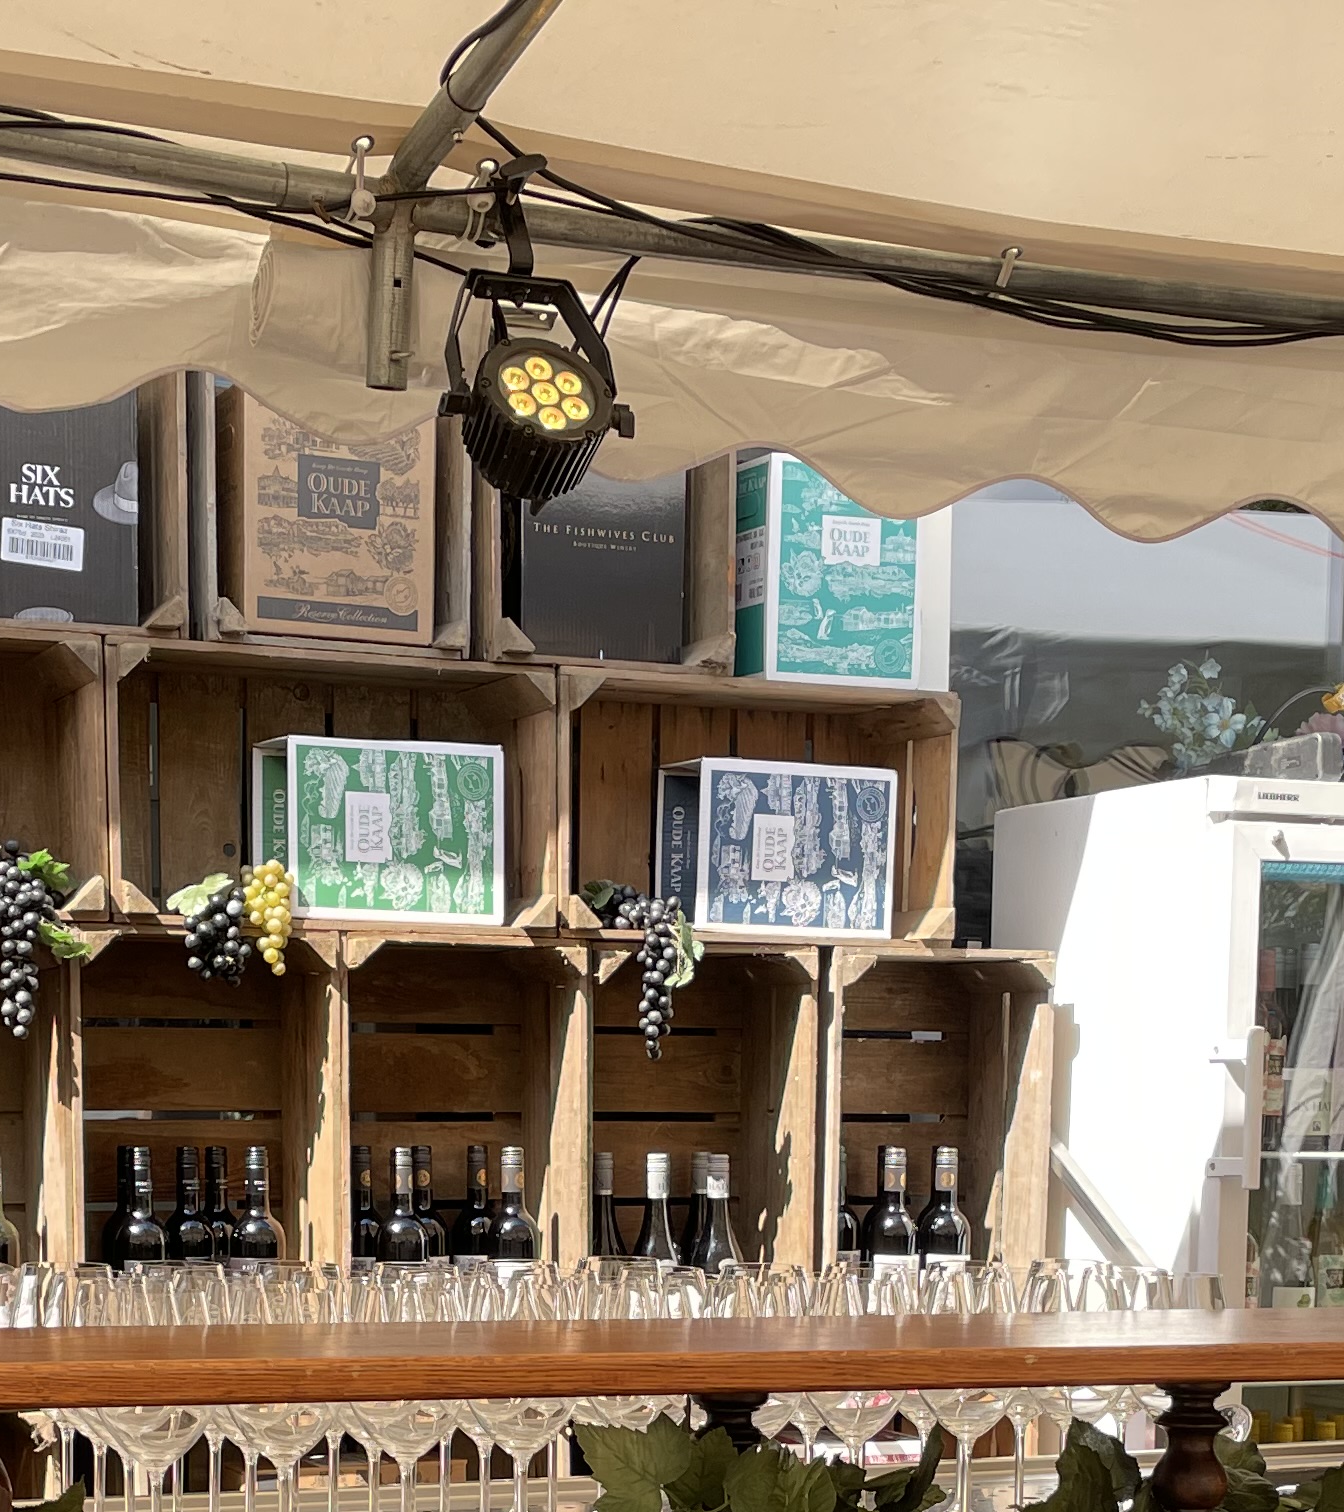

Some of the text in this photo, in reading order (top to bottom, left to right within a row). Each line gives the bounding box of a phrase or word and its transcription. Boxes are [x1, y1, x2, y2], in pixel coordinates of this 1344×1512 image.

[21, 463, 61, 486] SIX
[307, 472, 371, 498] OUDE
[9, 483, 74, 508] HATS
[311, 492, 370, 517] KAAP
[533, 521, 675, 544] THE FISHWIVES CLUB
[829, 527, 872, 544] OUDE
[831, 541, 870, 558] KAAP
[337, 606, 388, 624] Collection
[272, 788, 287, 859] OUDE KA
[357, 804, 371, 854] OUDE
[370, 805, 384, 852] KAAP
[670, 805, 686, 893] OUDE KAAP
[762, 827, 776, 873] OUDE
[775, 827, 788, 871] KAAP
